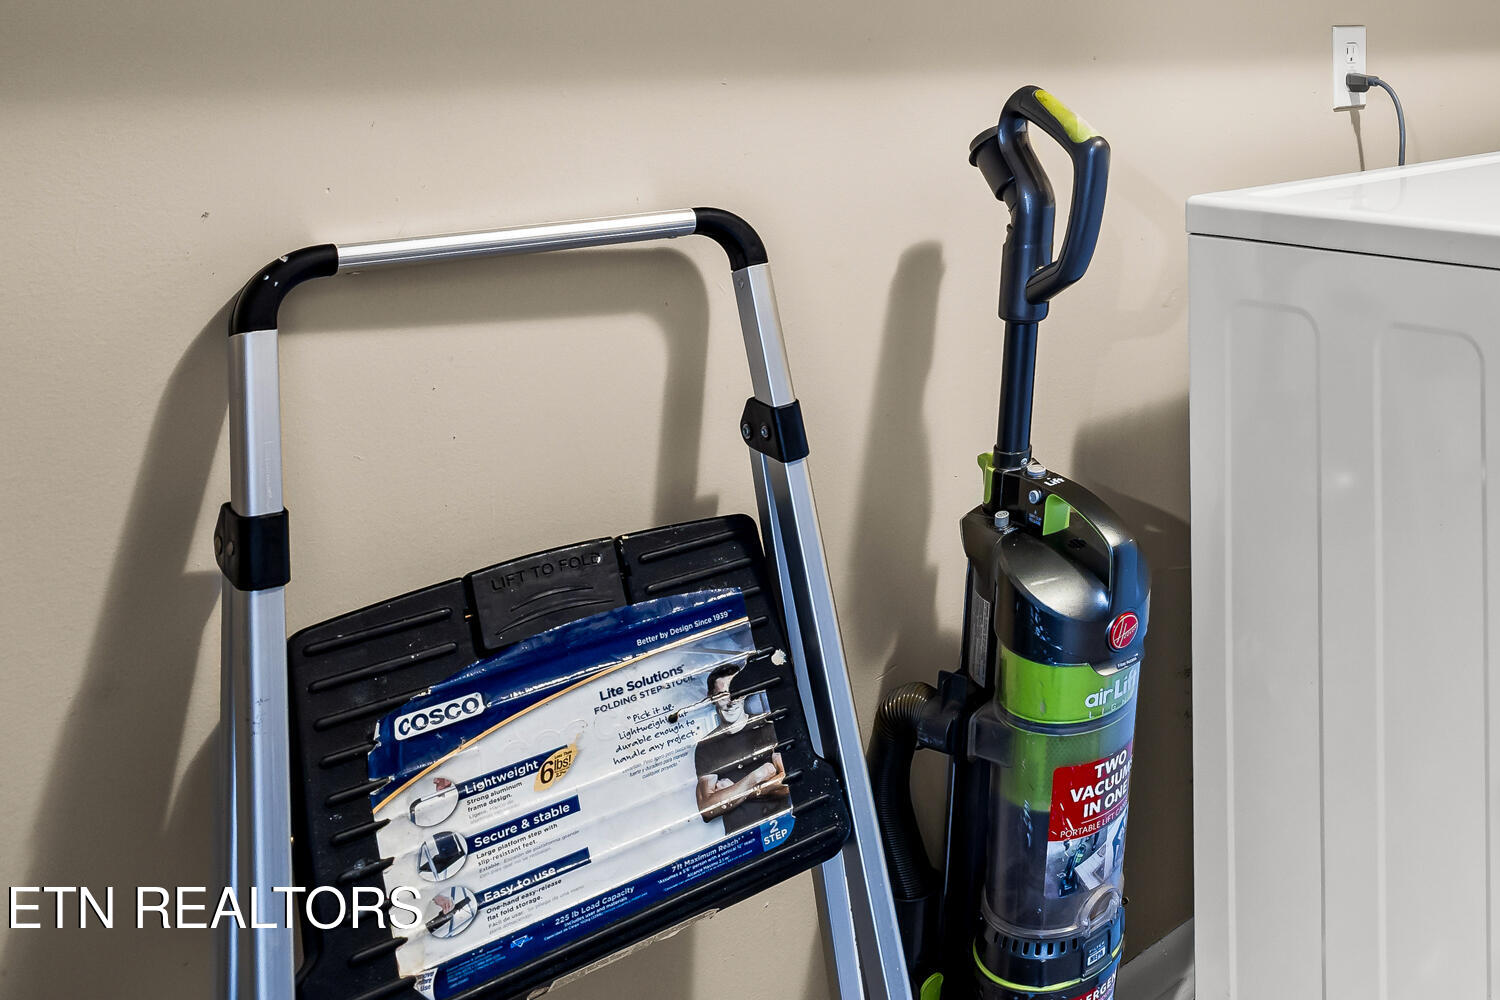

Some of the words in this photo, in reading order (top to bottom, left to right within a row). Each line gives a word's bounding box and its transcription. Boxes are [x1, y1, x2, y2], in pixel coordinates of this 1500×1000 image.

[491, 570, 525, 591] LIFT
[530, 563, 553, 578] TO
[559, 551, 604, 571] FOLD
[636, 634, 658, 647] Better
[659, 631, 669, 640] by
[670, 623, 693, 636] Design
[694, 618, 713, 628] Since
[713, 610, 729, 622] 1939
[599, 685, 624, 701] Lite
[626, 665, 684, 692] Solutions
[594, 694, 637, 714] FOLDING
[640, 684, 662, 699] STEP
[397, 697, 481, 736] COSCO
[615, 734, 653, 753] durable
[654, 722, 684, 739] enough
[686, 720, 695, 728] to
[540, 761, 554, 784] 6
[554, 754, 572, 771] lbs!
[613, 748, 646, 765] handle
[648, 742, 665, 752] any
[1094, 749, 1127, 778] TWO
[464, 760, 539, 795] Lightweight
[466, 793, 489, 806] Strong
[490, 782, 523, 796] aluminum
[467, 802, 487, 812] frame
[488, 793, 513, 805] design.
[1083, 799, 1101, 818] IN
[1105, 780, 1127, 808] ONE
[474, 824, 518, 848] Secure
[521, 818, 531, 829] &
[533, 803, 570, 825] stable
[476, 848, 496, 859] Large
[498, 837, 527, 851] platform
[528, 830, 542, 839] step
[543, 823, 558, 832] with
[763, 828, 788, 846] STEP
[769, 820, 779, 834] 2
[1060, 821, 1101, 838] PORTABLE
[1102, 813, 1115, 826] LIFT
[478, 846, 521, 866] slip-resistant
[684, 848, 717, 867] Maximum
[483, 883, 514, 903] Easy
[516, 877, 531, 889] to
[533, 867, 557, 881] use
[486, 895, 520, 914] One-hand
[521, 879, 562, 900] easy-release
[487, 913, 499, 922] flat
[500, 906, 514, 915] fold
[515, 895, 543, 910] storage.
[555, 913, 570, 926] 225
[571, 910, 580, 919] lb
[581, 901, 601, 914] Load
[601, 886, 635, 905] Capacity
